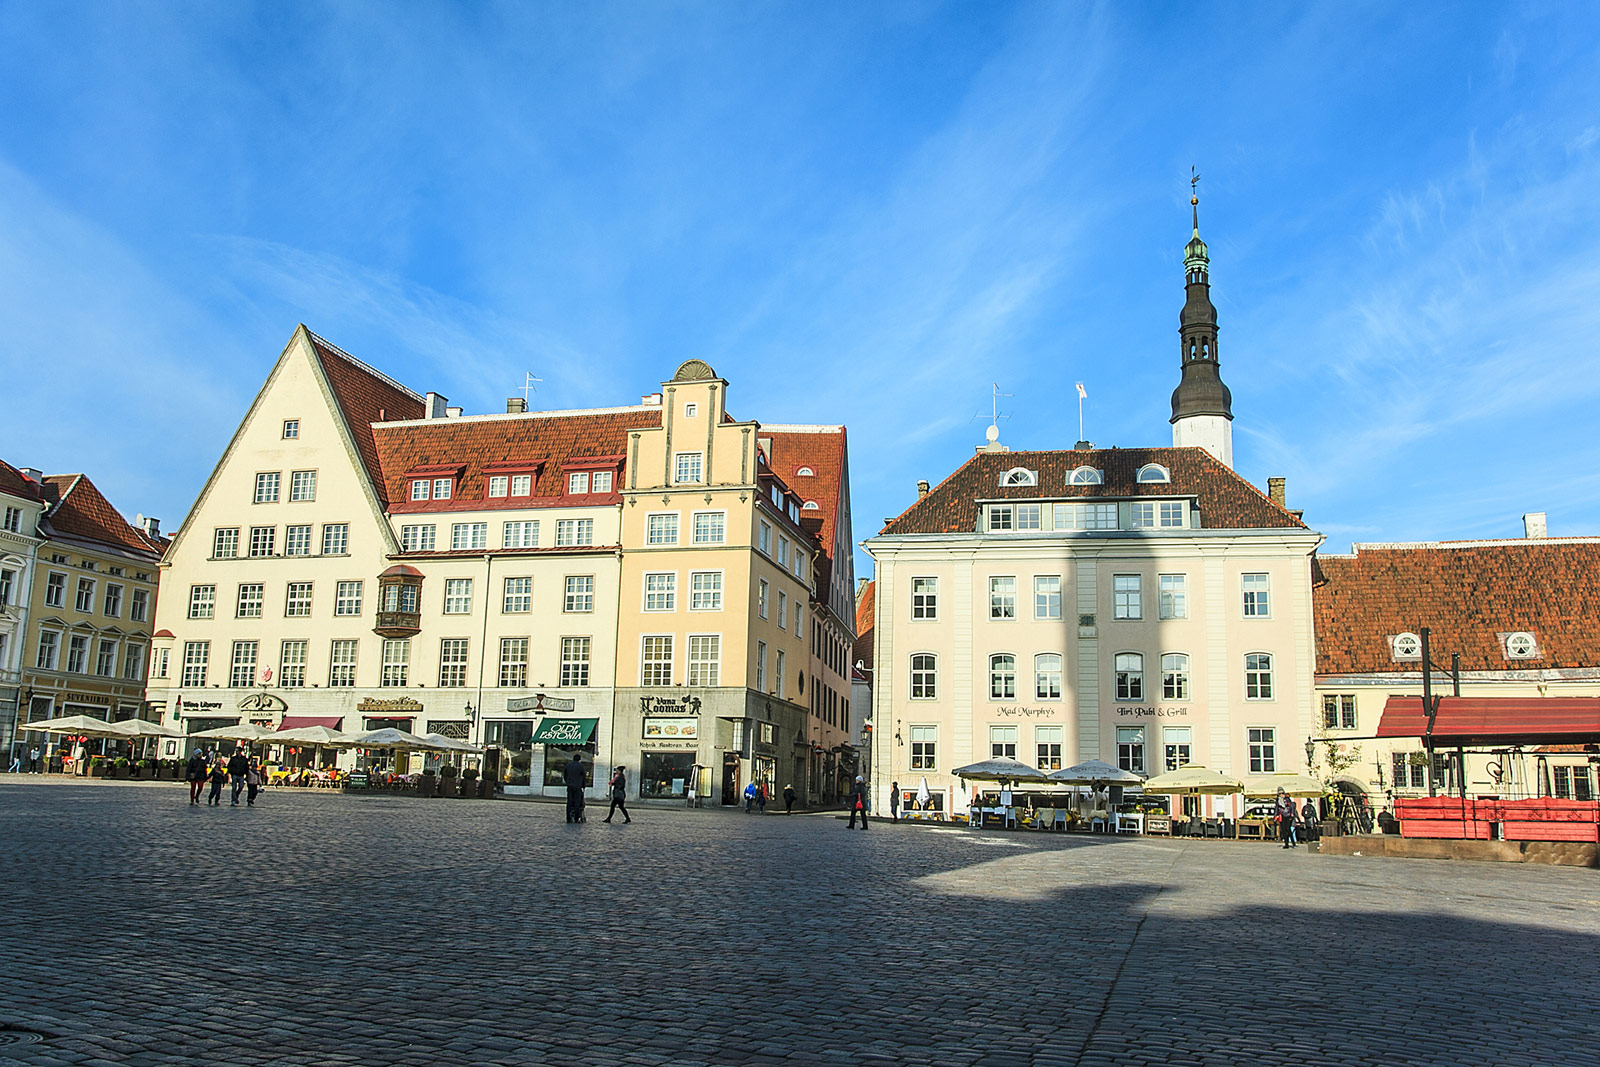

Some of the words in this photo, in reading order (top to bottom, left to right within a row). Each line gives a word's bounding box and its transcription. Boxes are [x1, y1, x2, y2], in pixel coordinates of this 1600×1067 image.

[200, 700, 222, 709] Library
[656, 696, 676, 705] Vana
[996, 706, 1017, 717] Mad
[1017, 706, 1055, 718] Murphy's
[1134, 707, 1156, 719] Pubi
[1157, 708, 1165, 717] &
[1166, 707, 1188, 717] Grill
[550, 724, 580, 733] OLDE
[539, 731, 582, 740] ESTONIA
